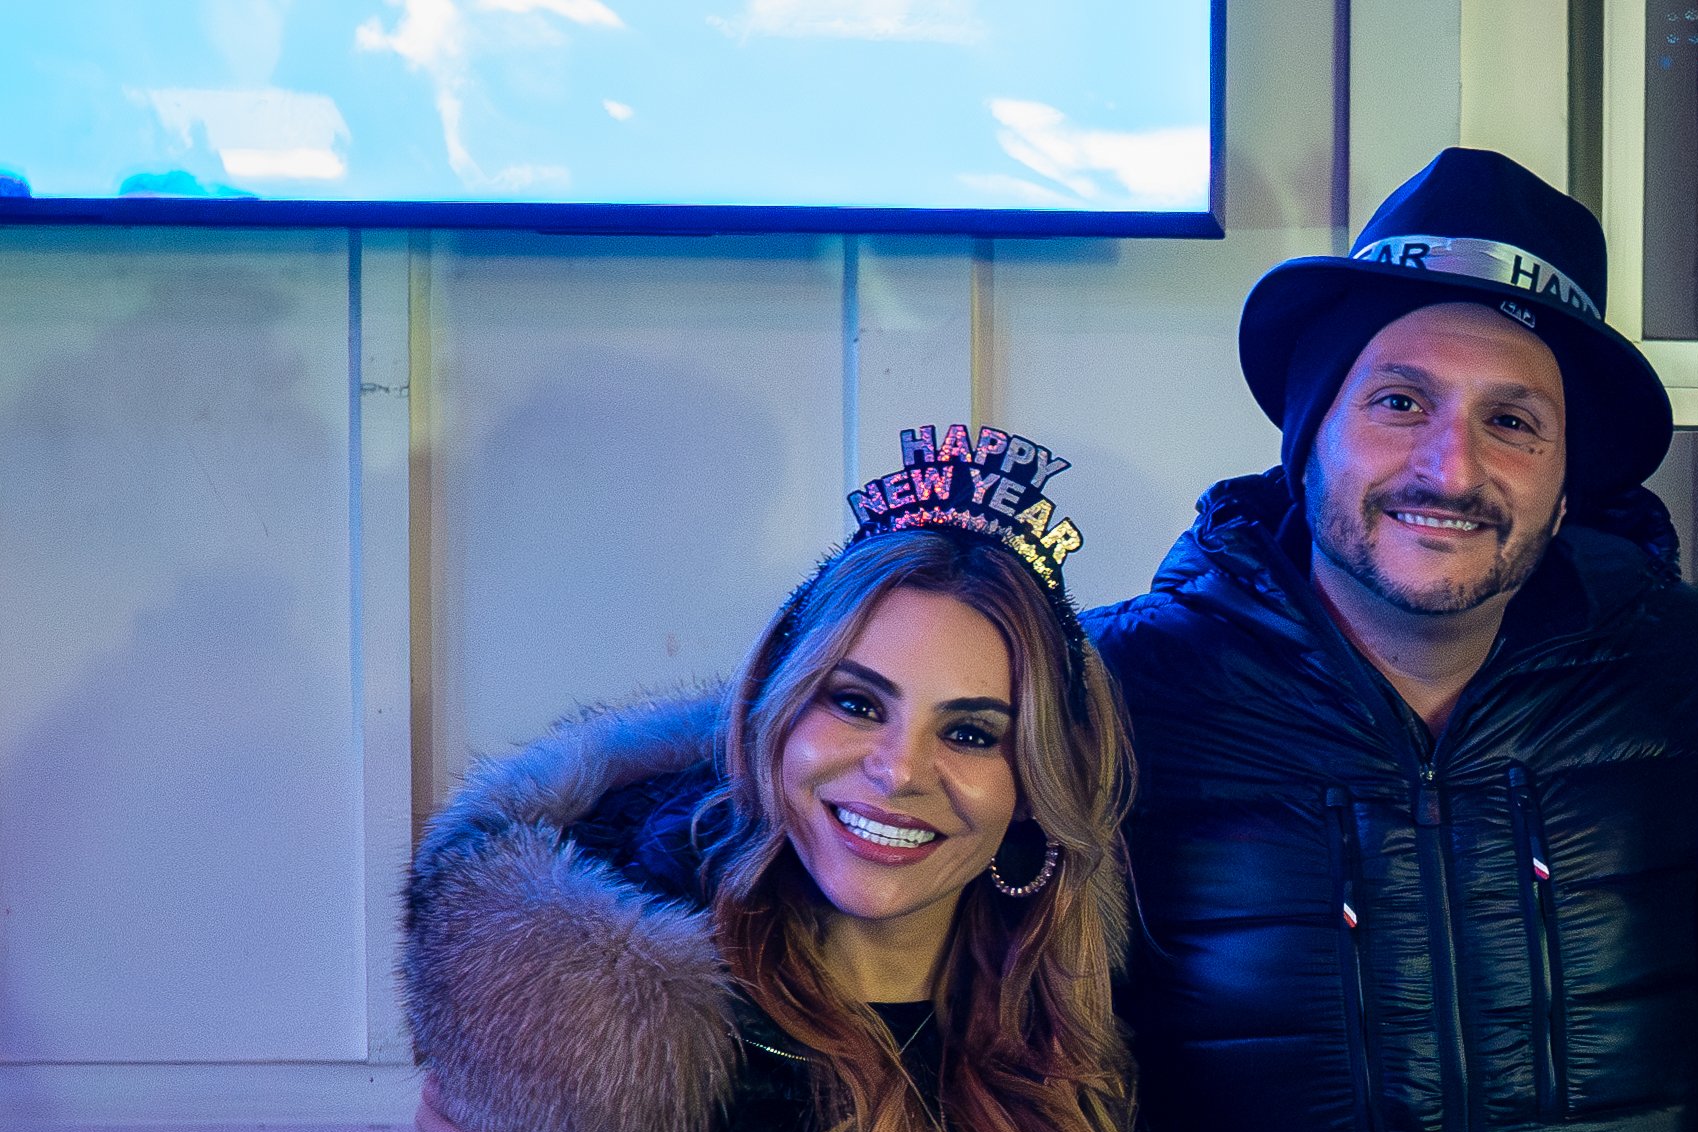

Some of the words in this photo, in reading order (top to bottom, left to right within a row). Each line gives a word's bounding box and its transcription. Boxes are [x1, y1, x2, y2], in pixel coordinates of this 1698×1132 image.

[1363, 243, 1431, 271] AR
[900, 424, 1071, 488] HAPPY
[848, 465, 955, 525] NEW
[970, 467, 1085, 566] YEAR
